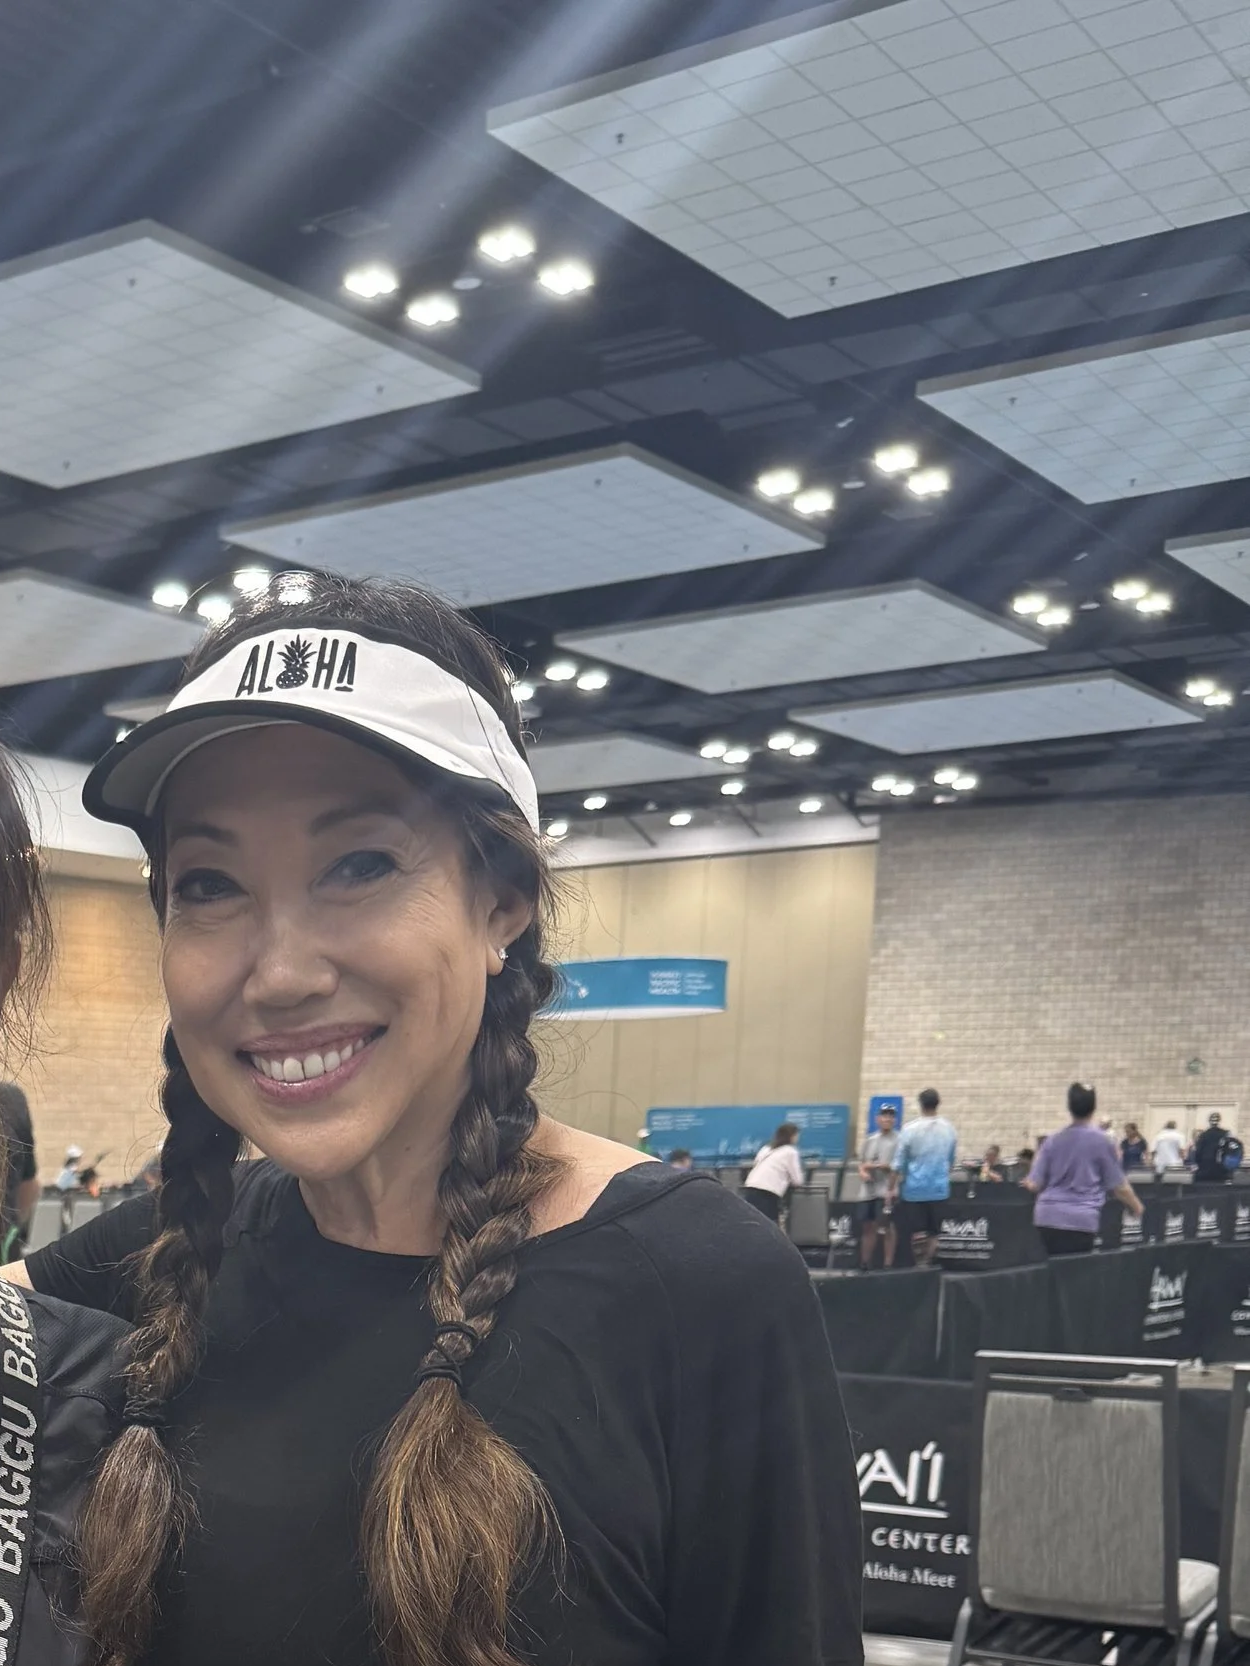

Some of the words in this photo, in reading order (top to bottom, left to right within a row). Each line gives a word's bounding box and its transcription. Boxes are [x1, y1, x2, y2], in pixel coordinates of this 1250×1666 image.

[870, 1526, 972, 1555] CENTER
[862, 1561, 908, 1584] Aloha
[910, 1566, 956, 1589] Meet
